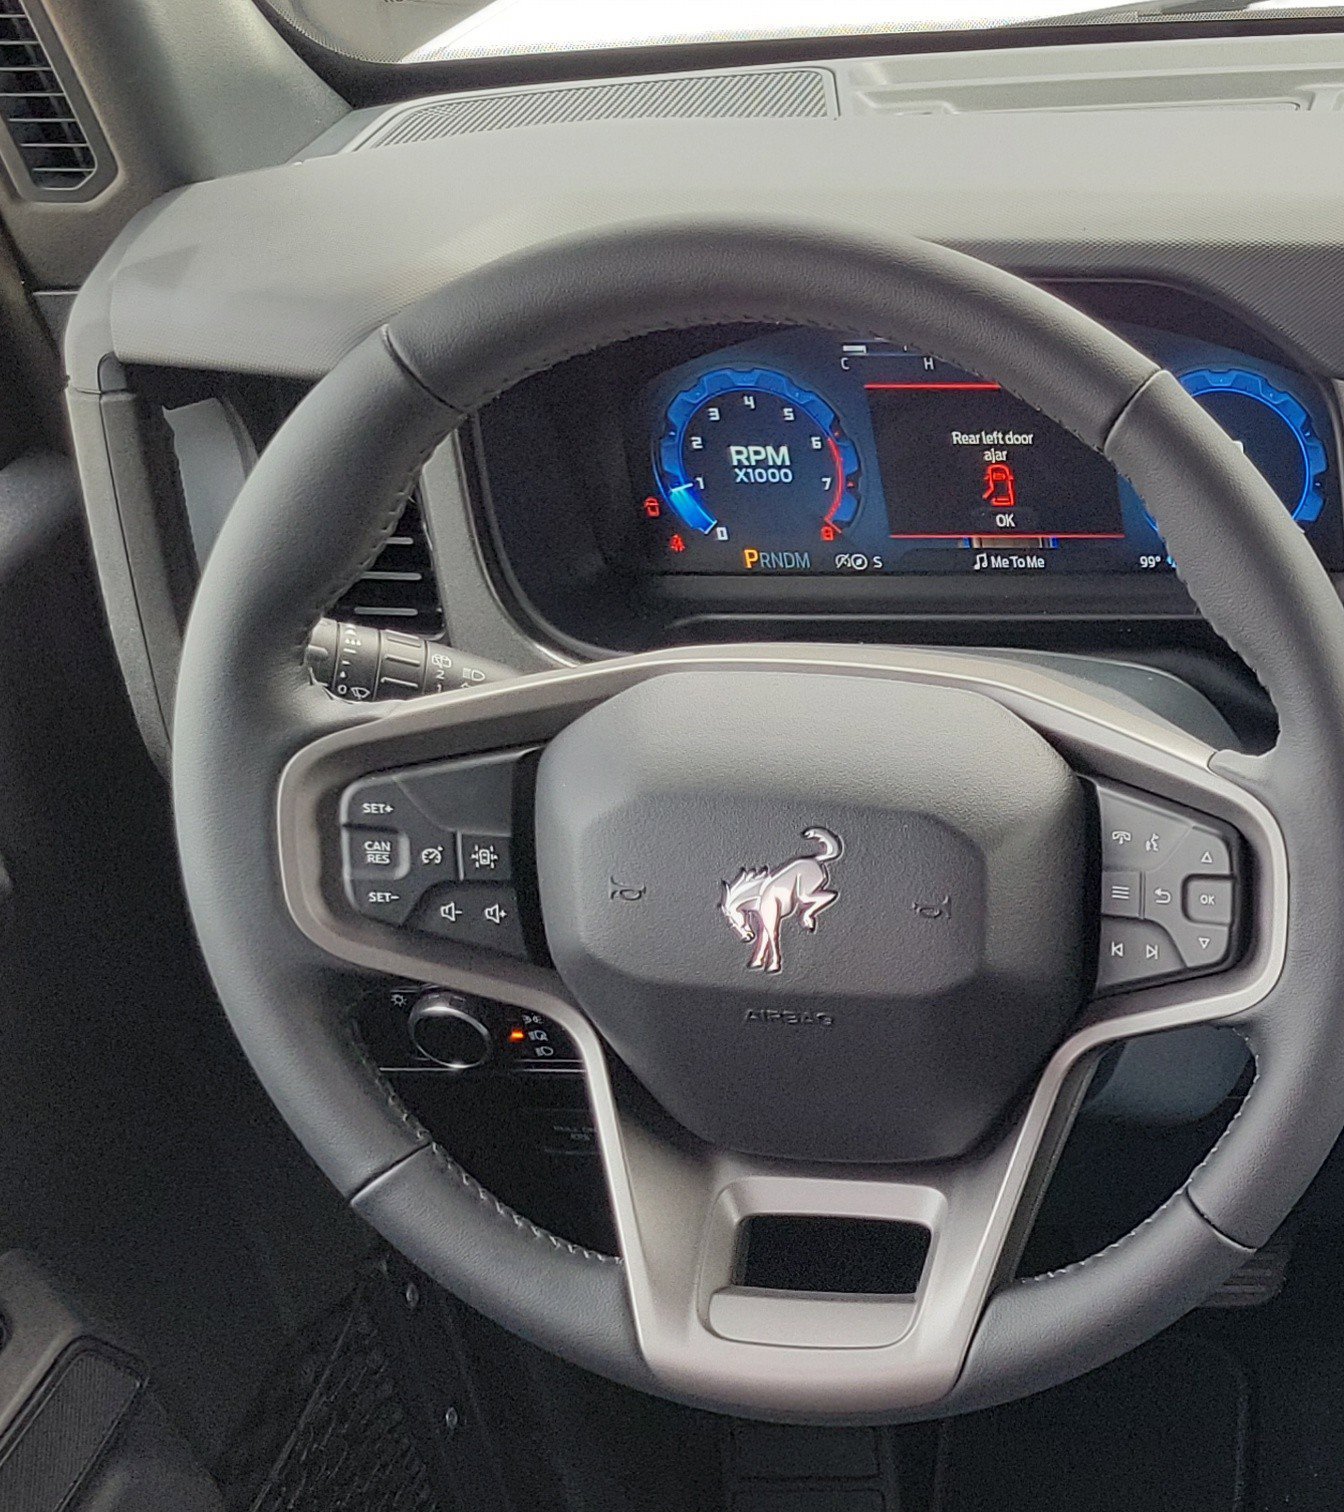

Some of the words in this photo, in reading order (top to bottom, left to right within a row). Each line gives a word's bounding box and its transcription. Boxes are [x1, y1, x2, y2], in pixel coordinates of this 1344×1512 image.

[841, 358, 849, 370] C
[924, 357, 934, 370] H
[744, 396, 755, 409] 4
[708, 408, 720, 421] 3
[783, 408, 794, 421] 5
[691, 437, 703, 449] 2
[811, 437, 822, 449] 6
[952, 431, 980, 445] Rear
[982, 431, 1004, 444] left
[1006, 431, 1033, 444] door
[730, 446, 791, 466] RPM
[983, 448, 1008, 463] ajar
[735, 469, 792, 483] X1000
[696, 477, 704, 489] 1
[822, 478, 831, 490] 7
[996, 514, 1015, 527] OK
[716, 527, 729, 540] 0
[991, 555, 1010, 568] Me
[1010, 556, 1025, 567] To
[1027, 556, 1045, 568] Me
[362, 803, 394, 814] SET+
[364, 841, 391, 852] CAN
[366, 854, 390, 864] RES
[1200, 895, 1215, 905] OK
[743, 1009, 836, 1028] AIRBAG
